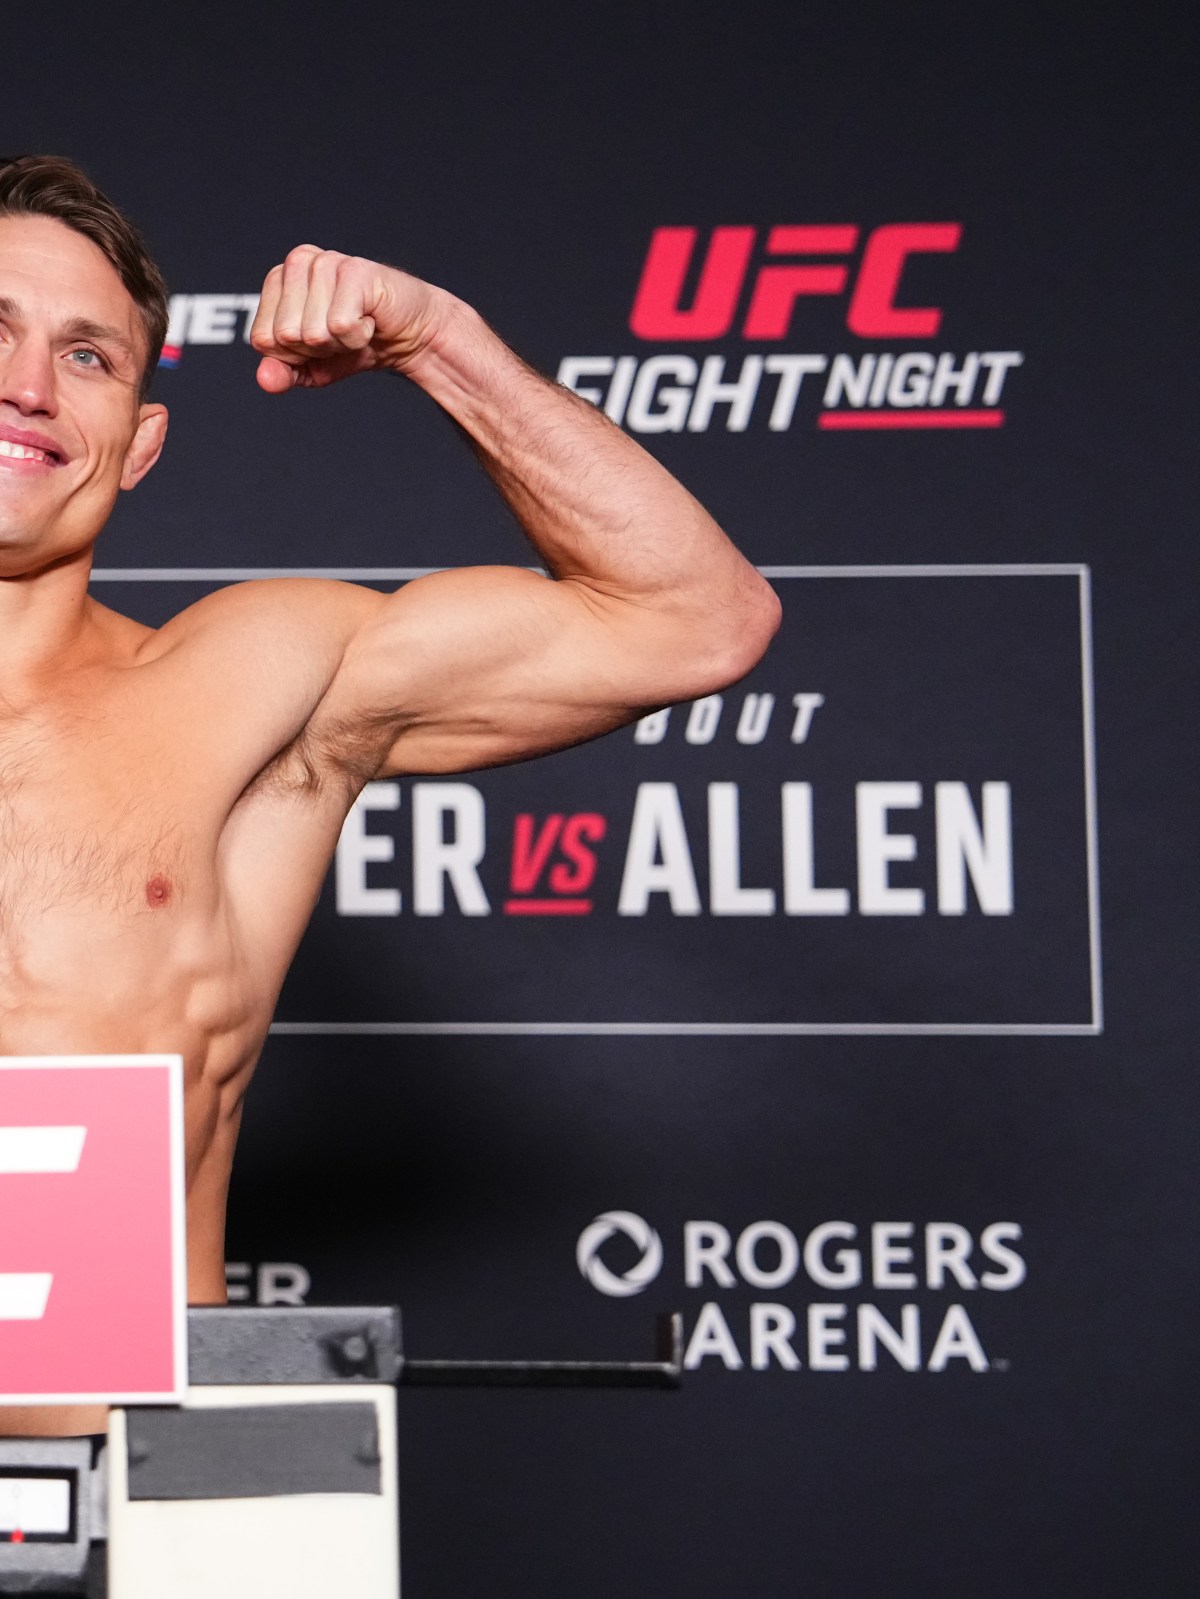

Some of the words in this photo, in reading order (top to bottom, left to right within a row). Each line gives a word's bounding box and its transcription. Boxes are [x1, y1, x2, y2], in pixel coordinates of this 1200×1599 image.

[629, 222, 962, 341] UFC
[556, 354, 826, 434] FIGHT
[822, 351, 1024, 408] NIGHT
[634, 693, 825, 745] BOUT
[510, 813, 606, 895] VS
[618, 781, 1014, 916] ALLEN
[684, 1220, 1026, 1291] ROGERS
[684, 1302, 989, 1372] ARENA
